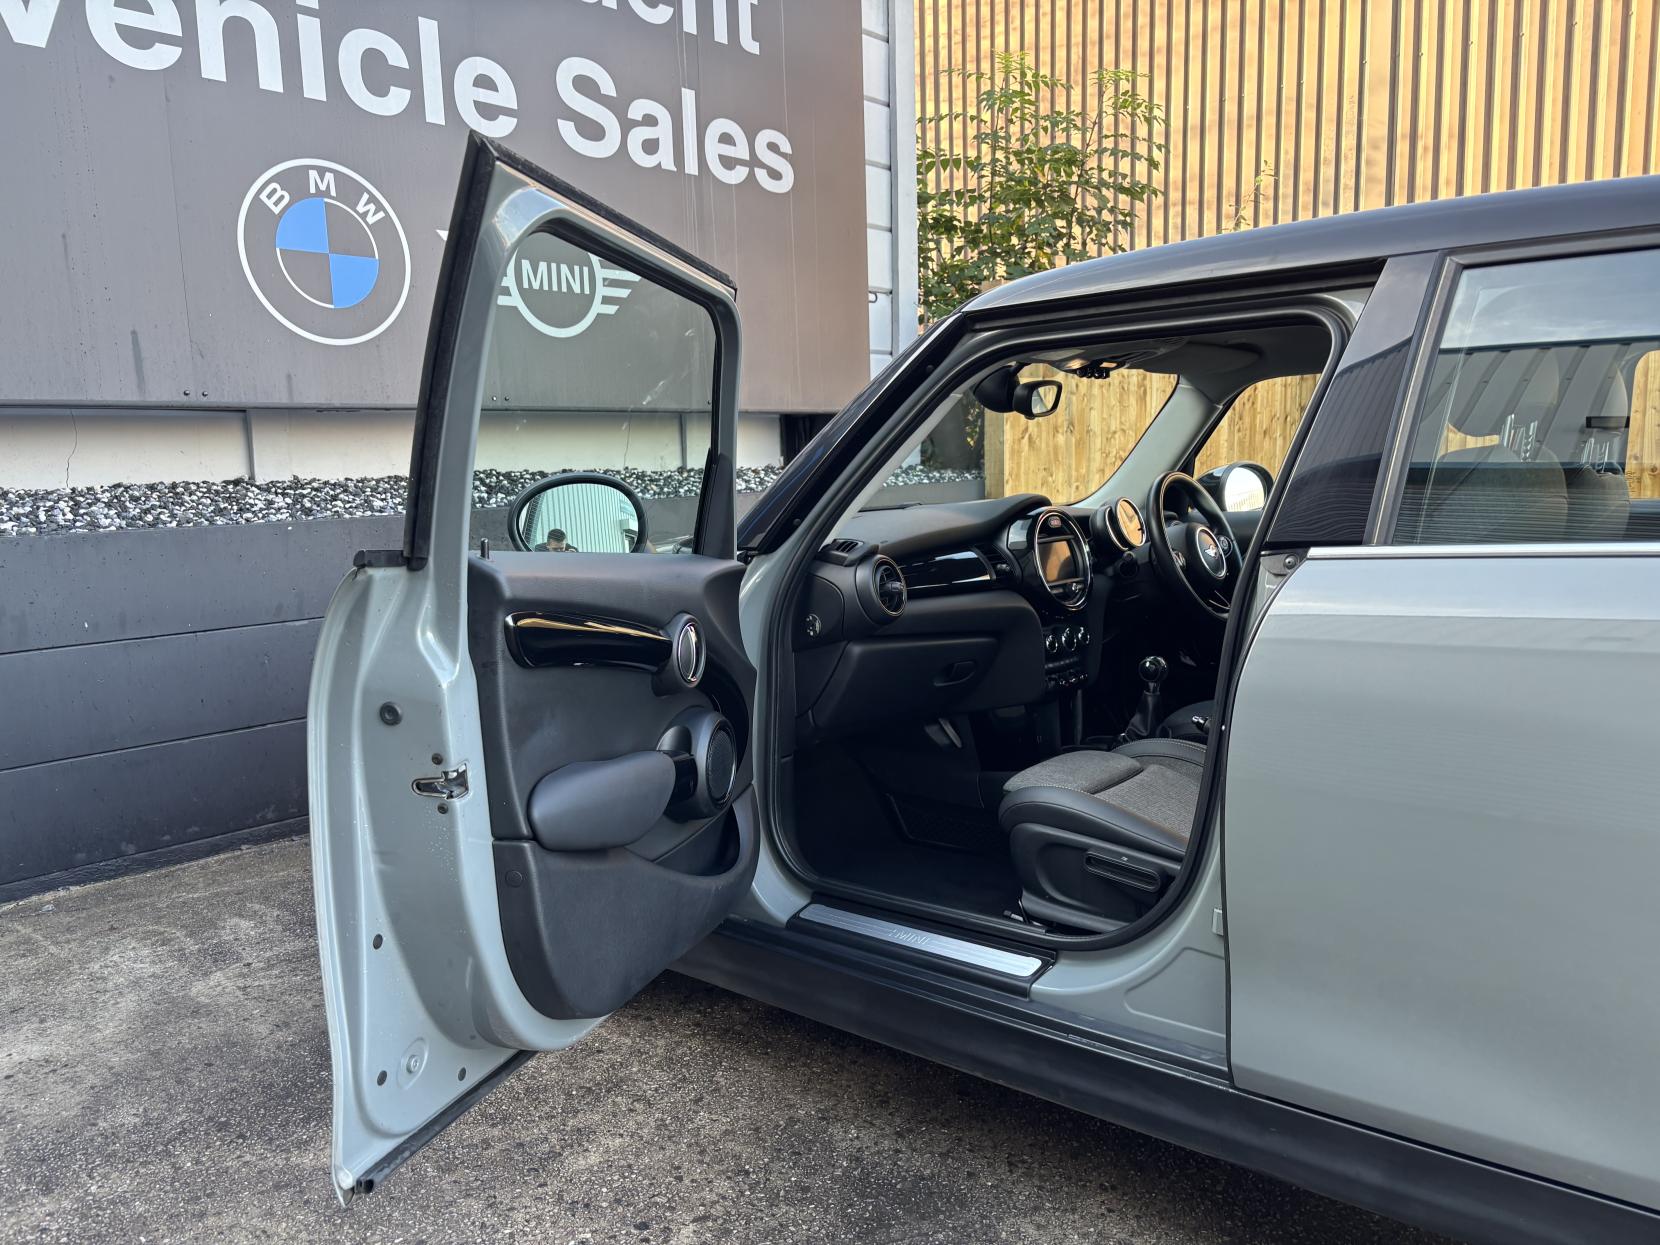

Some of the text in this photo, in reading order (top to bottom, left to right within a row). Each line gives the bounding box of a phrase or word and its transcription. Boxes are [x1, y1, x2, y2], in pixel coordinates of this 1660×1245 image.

[555, 56, 795, 194] Sales
[258, 169, 386, 226] BMW
[521, 259, 590, 295] MINI
